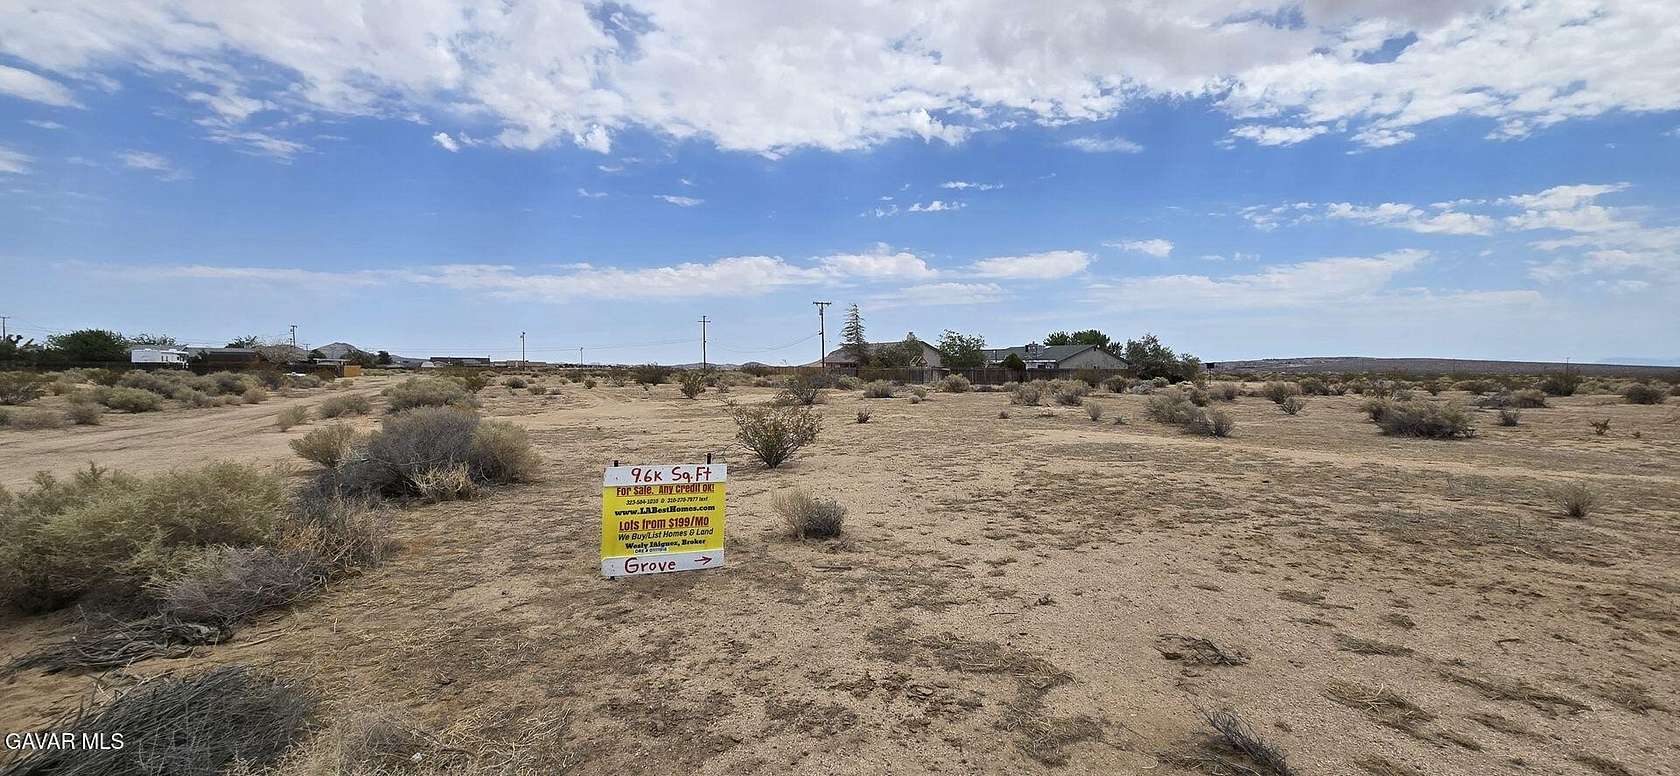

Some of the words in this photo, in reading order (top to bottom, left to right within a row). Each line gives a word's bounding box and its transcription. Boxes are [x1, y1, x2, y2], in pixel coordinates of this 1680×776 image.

[616, 486, 632, 496] For
[659, 484, 674, 494] Any
[615, 505, 715, 516] www.LABestHomes.com
[619, 520, 639, 531] Lots
[642, 518, 666, 529] from
[618, 533, 630, 541] We
[631, 530, 662, 541] Buy/List
[663, 530, 687, 538] Homes
[696, 528, 714, 536] Land
[624, 557, 677, 574] Grove
